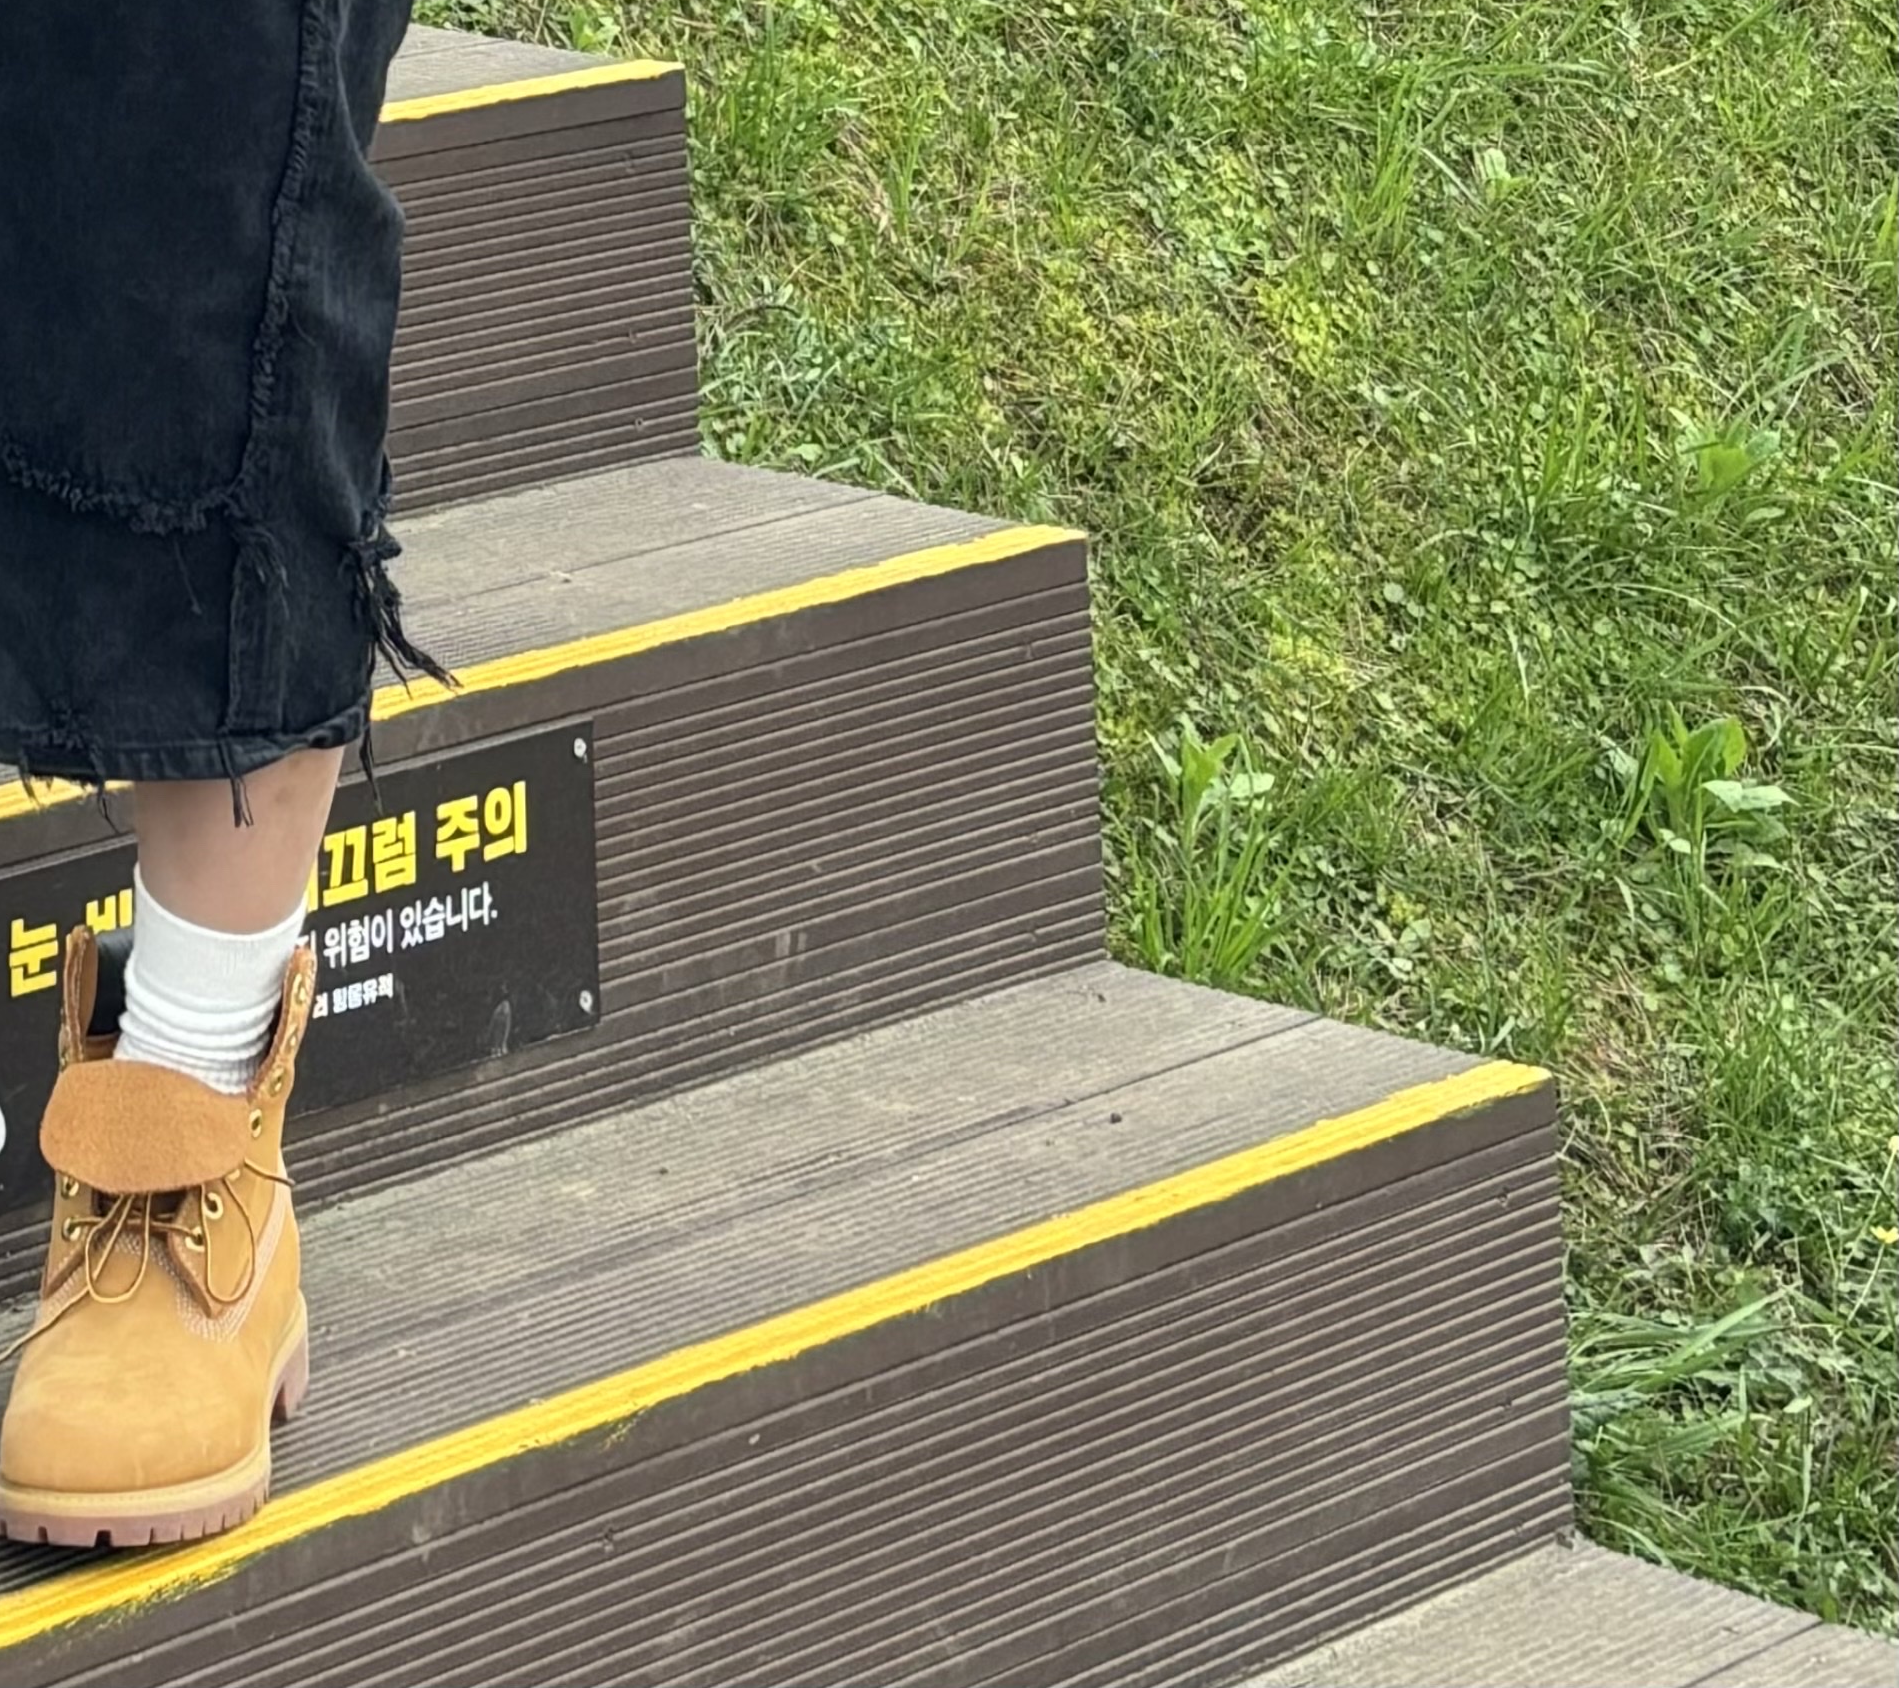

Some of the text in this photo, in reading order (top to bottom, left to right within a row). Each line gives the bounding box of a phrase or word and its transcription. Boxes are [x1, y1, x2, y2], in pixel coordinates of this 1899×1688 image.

[435, 780, 527, 873] 주의
[323, 881, 498, 969] 위험이 있습니다.
